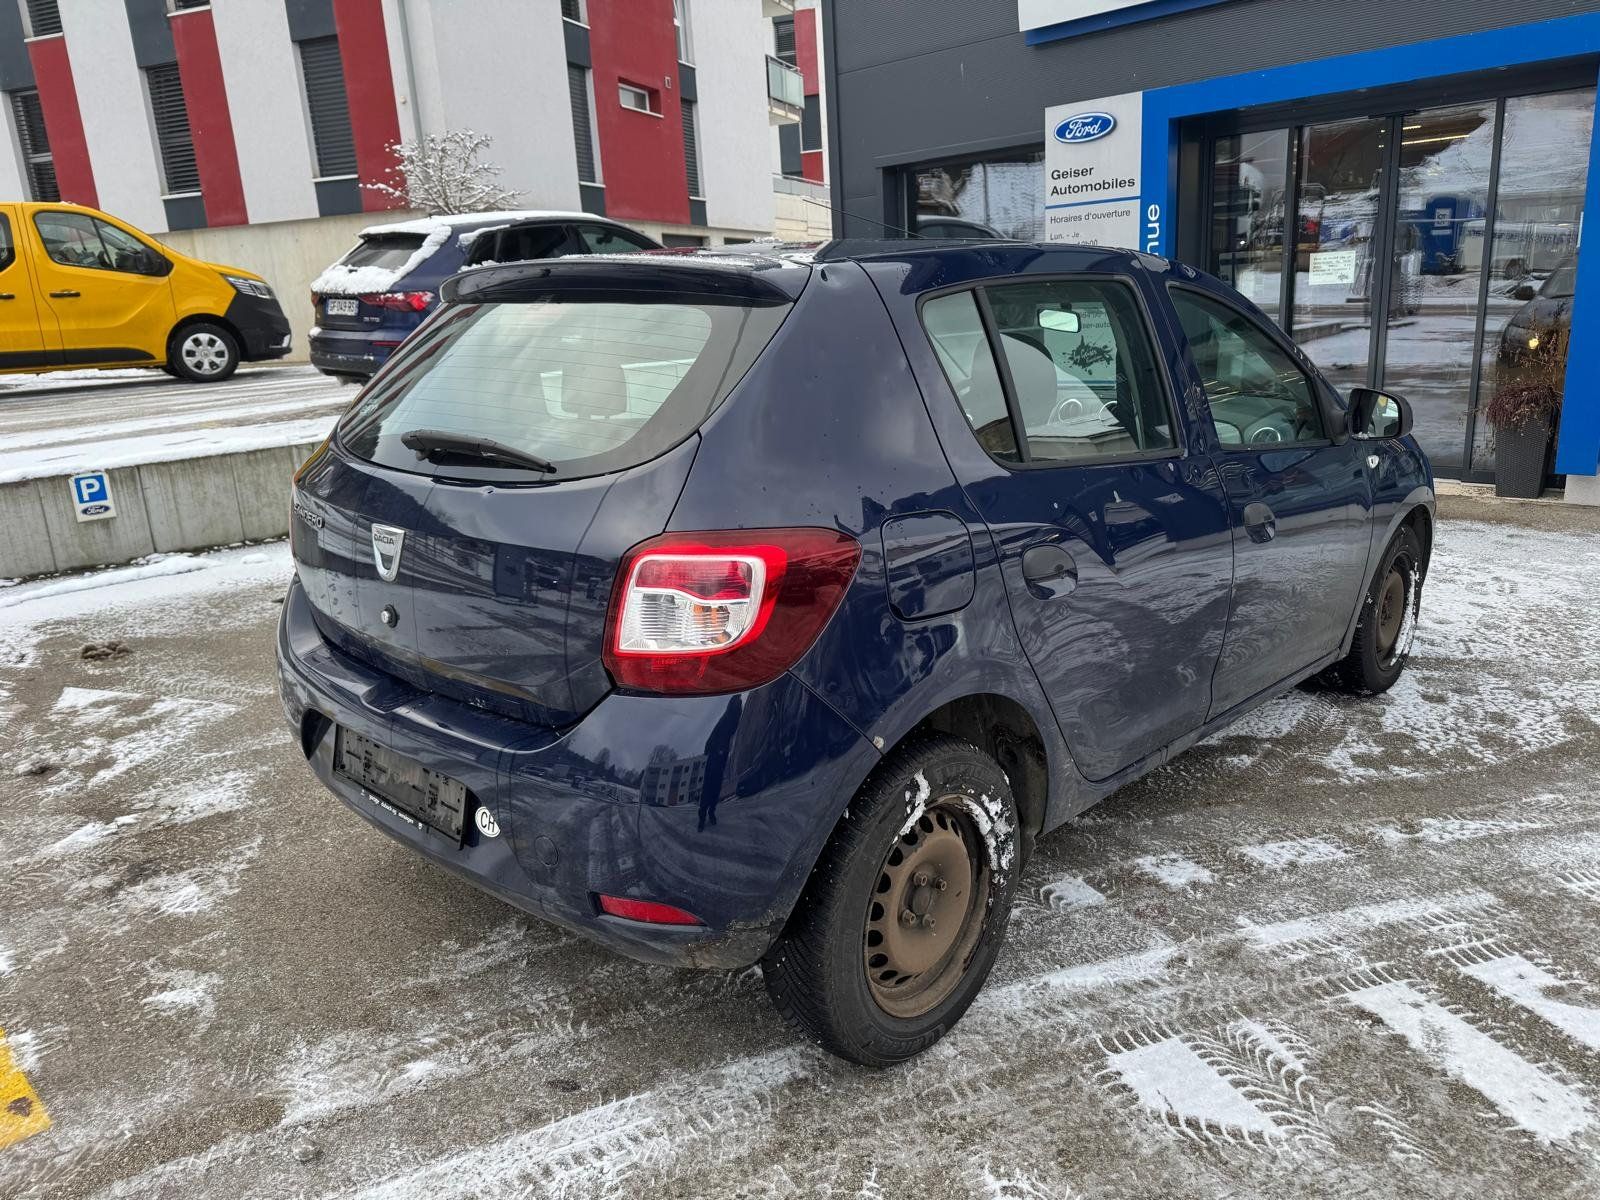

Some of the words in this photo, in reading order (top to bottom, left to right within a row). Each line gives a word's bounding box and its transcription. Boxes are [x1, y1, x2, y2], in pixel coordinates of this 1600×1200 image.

[1051, 166, 1094, 180] Geiser
[1050, 178, 1136, 197] Automobiles
[1050, 212, 1083, 225] Horaires
[1084, 208, 1131, 221] d'ouverture
[80, 478, 101, 502] P
[373, 533, 395, 546] DACIA
[480, 811, 496, 833] CH
